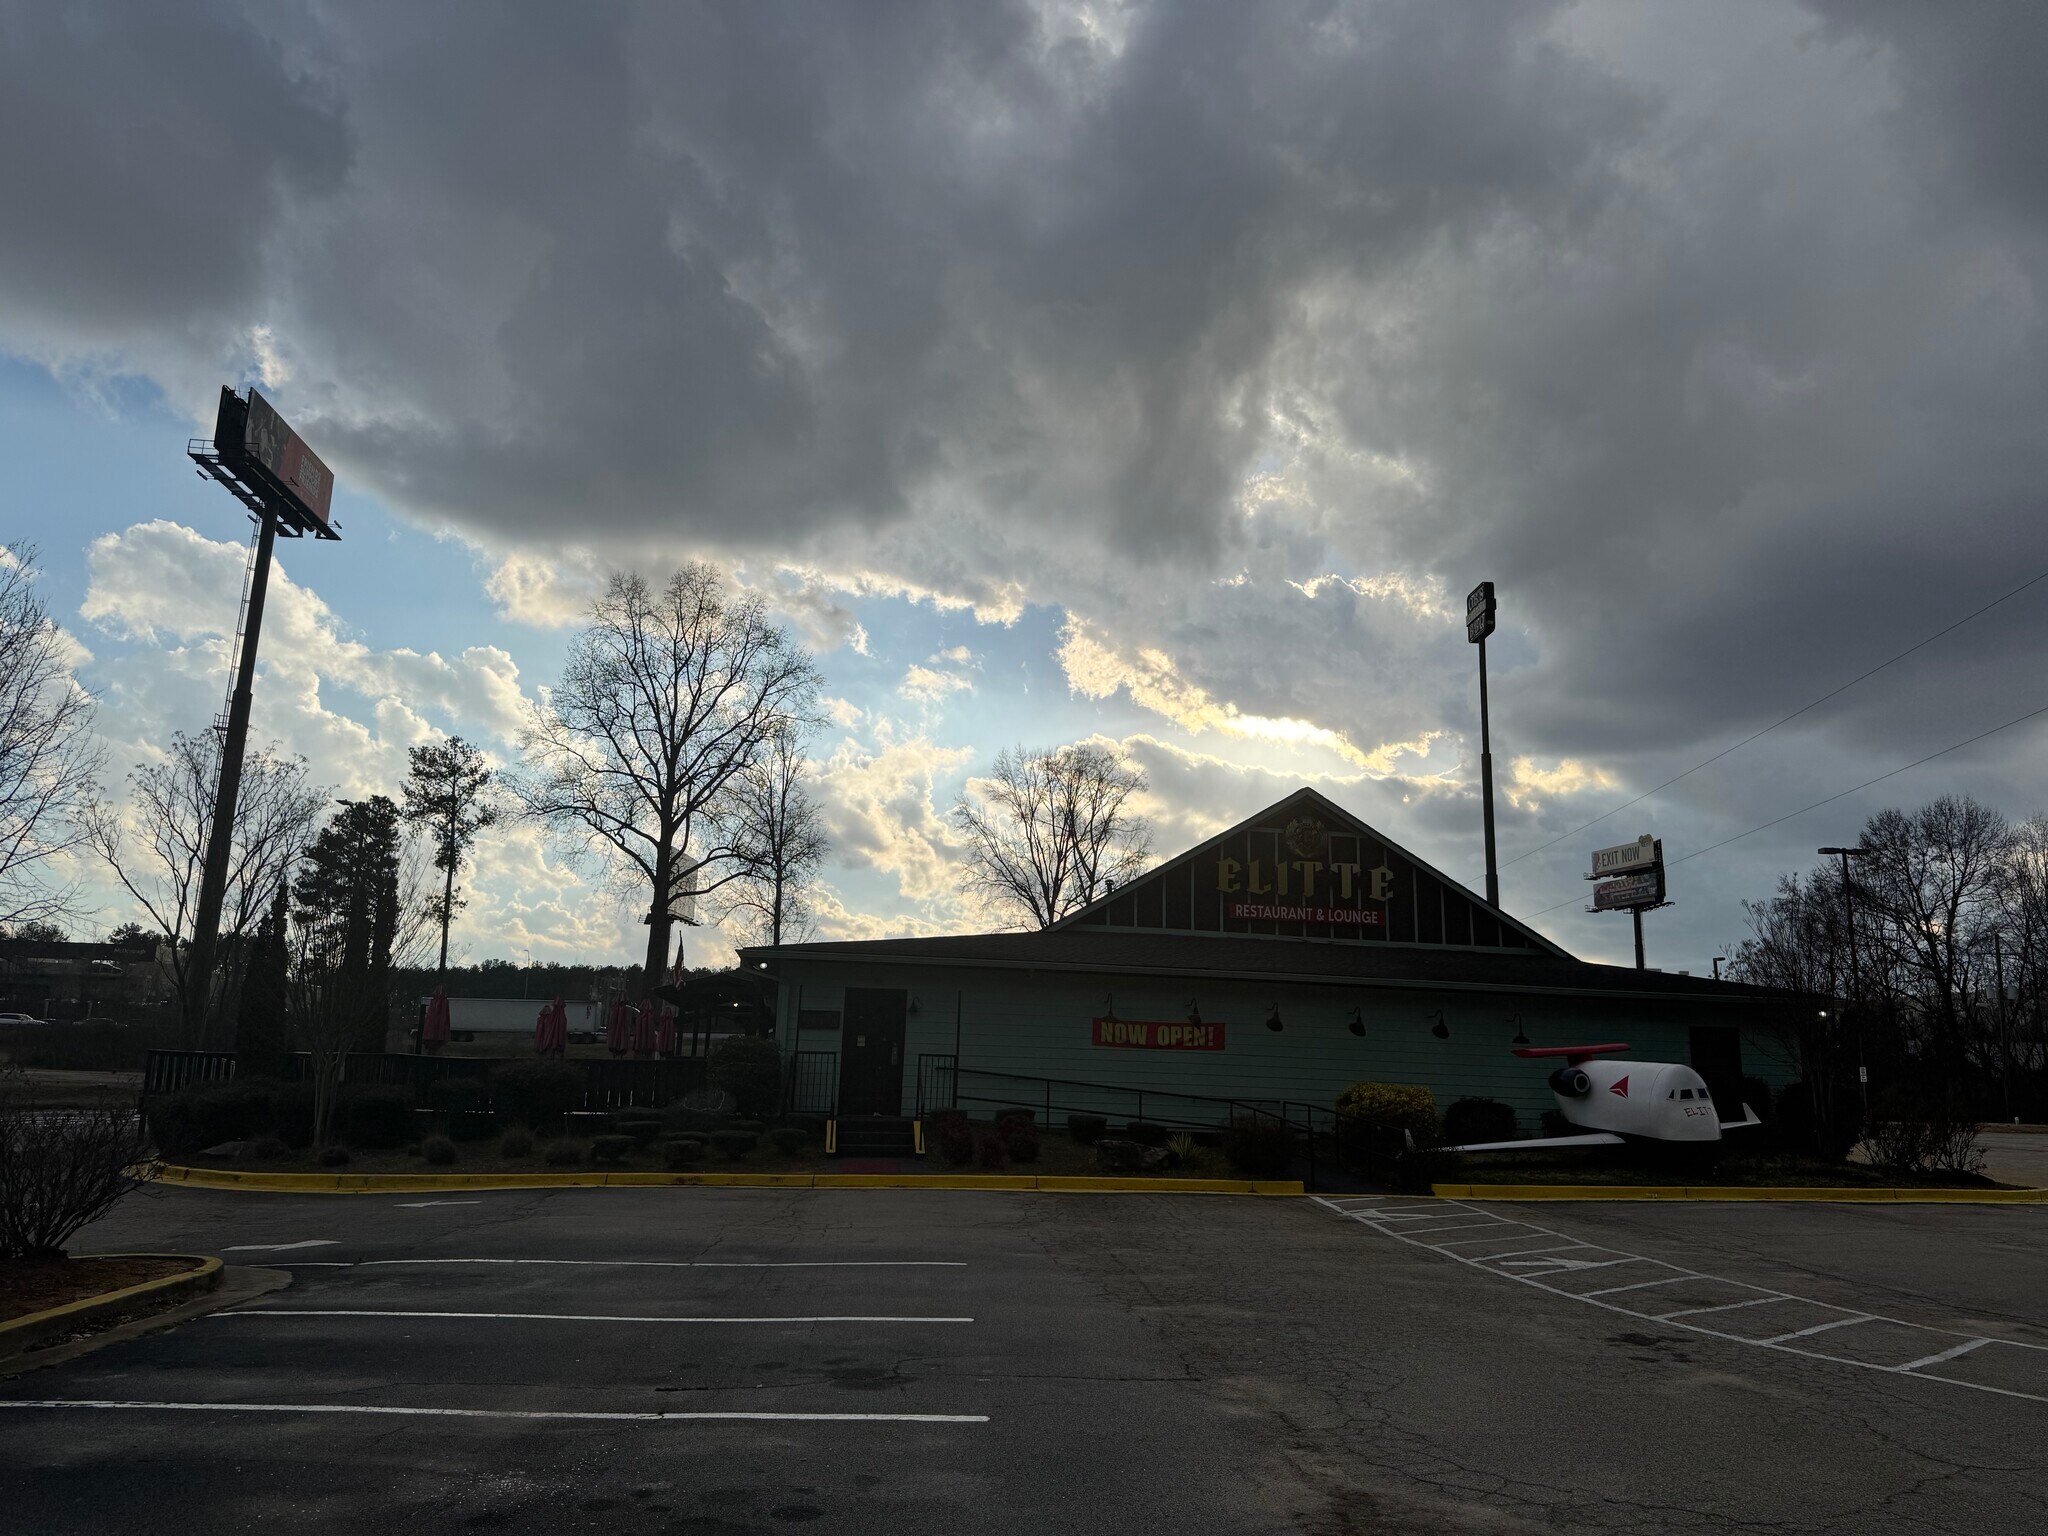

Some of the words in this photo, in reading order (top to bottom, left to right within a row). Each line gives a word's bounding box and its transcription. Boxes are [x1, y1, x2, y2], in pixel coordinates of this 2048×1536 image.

[1601, 850, 1619, 867] EXIT
[1621, 845, 1640, 863] NOW
[1216, 857, 1395, 902] ELITTE
[1235, 904, 1313, 921] RESTAURANT
[1316, 908, 1325, 921] &
[1328, 909, 1379, 924] LOUNGE
[1101, 1022, 1148, 1045] NOW
[1157, 1025, 1215, 1047] OPEN!
